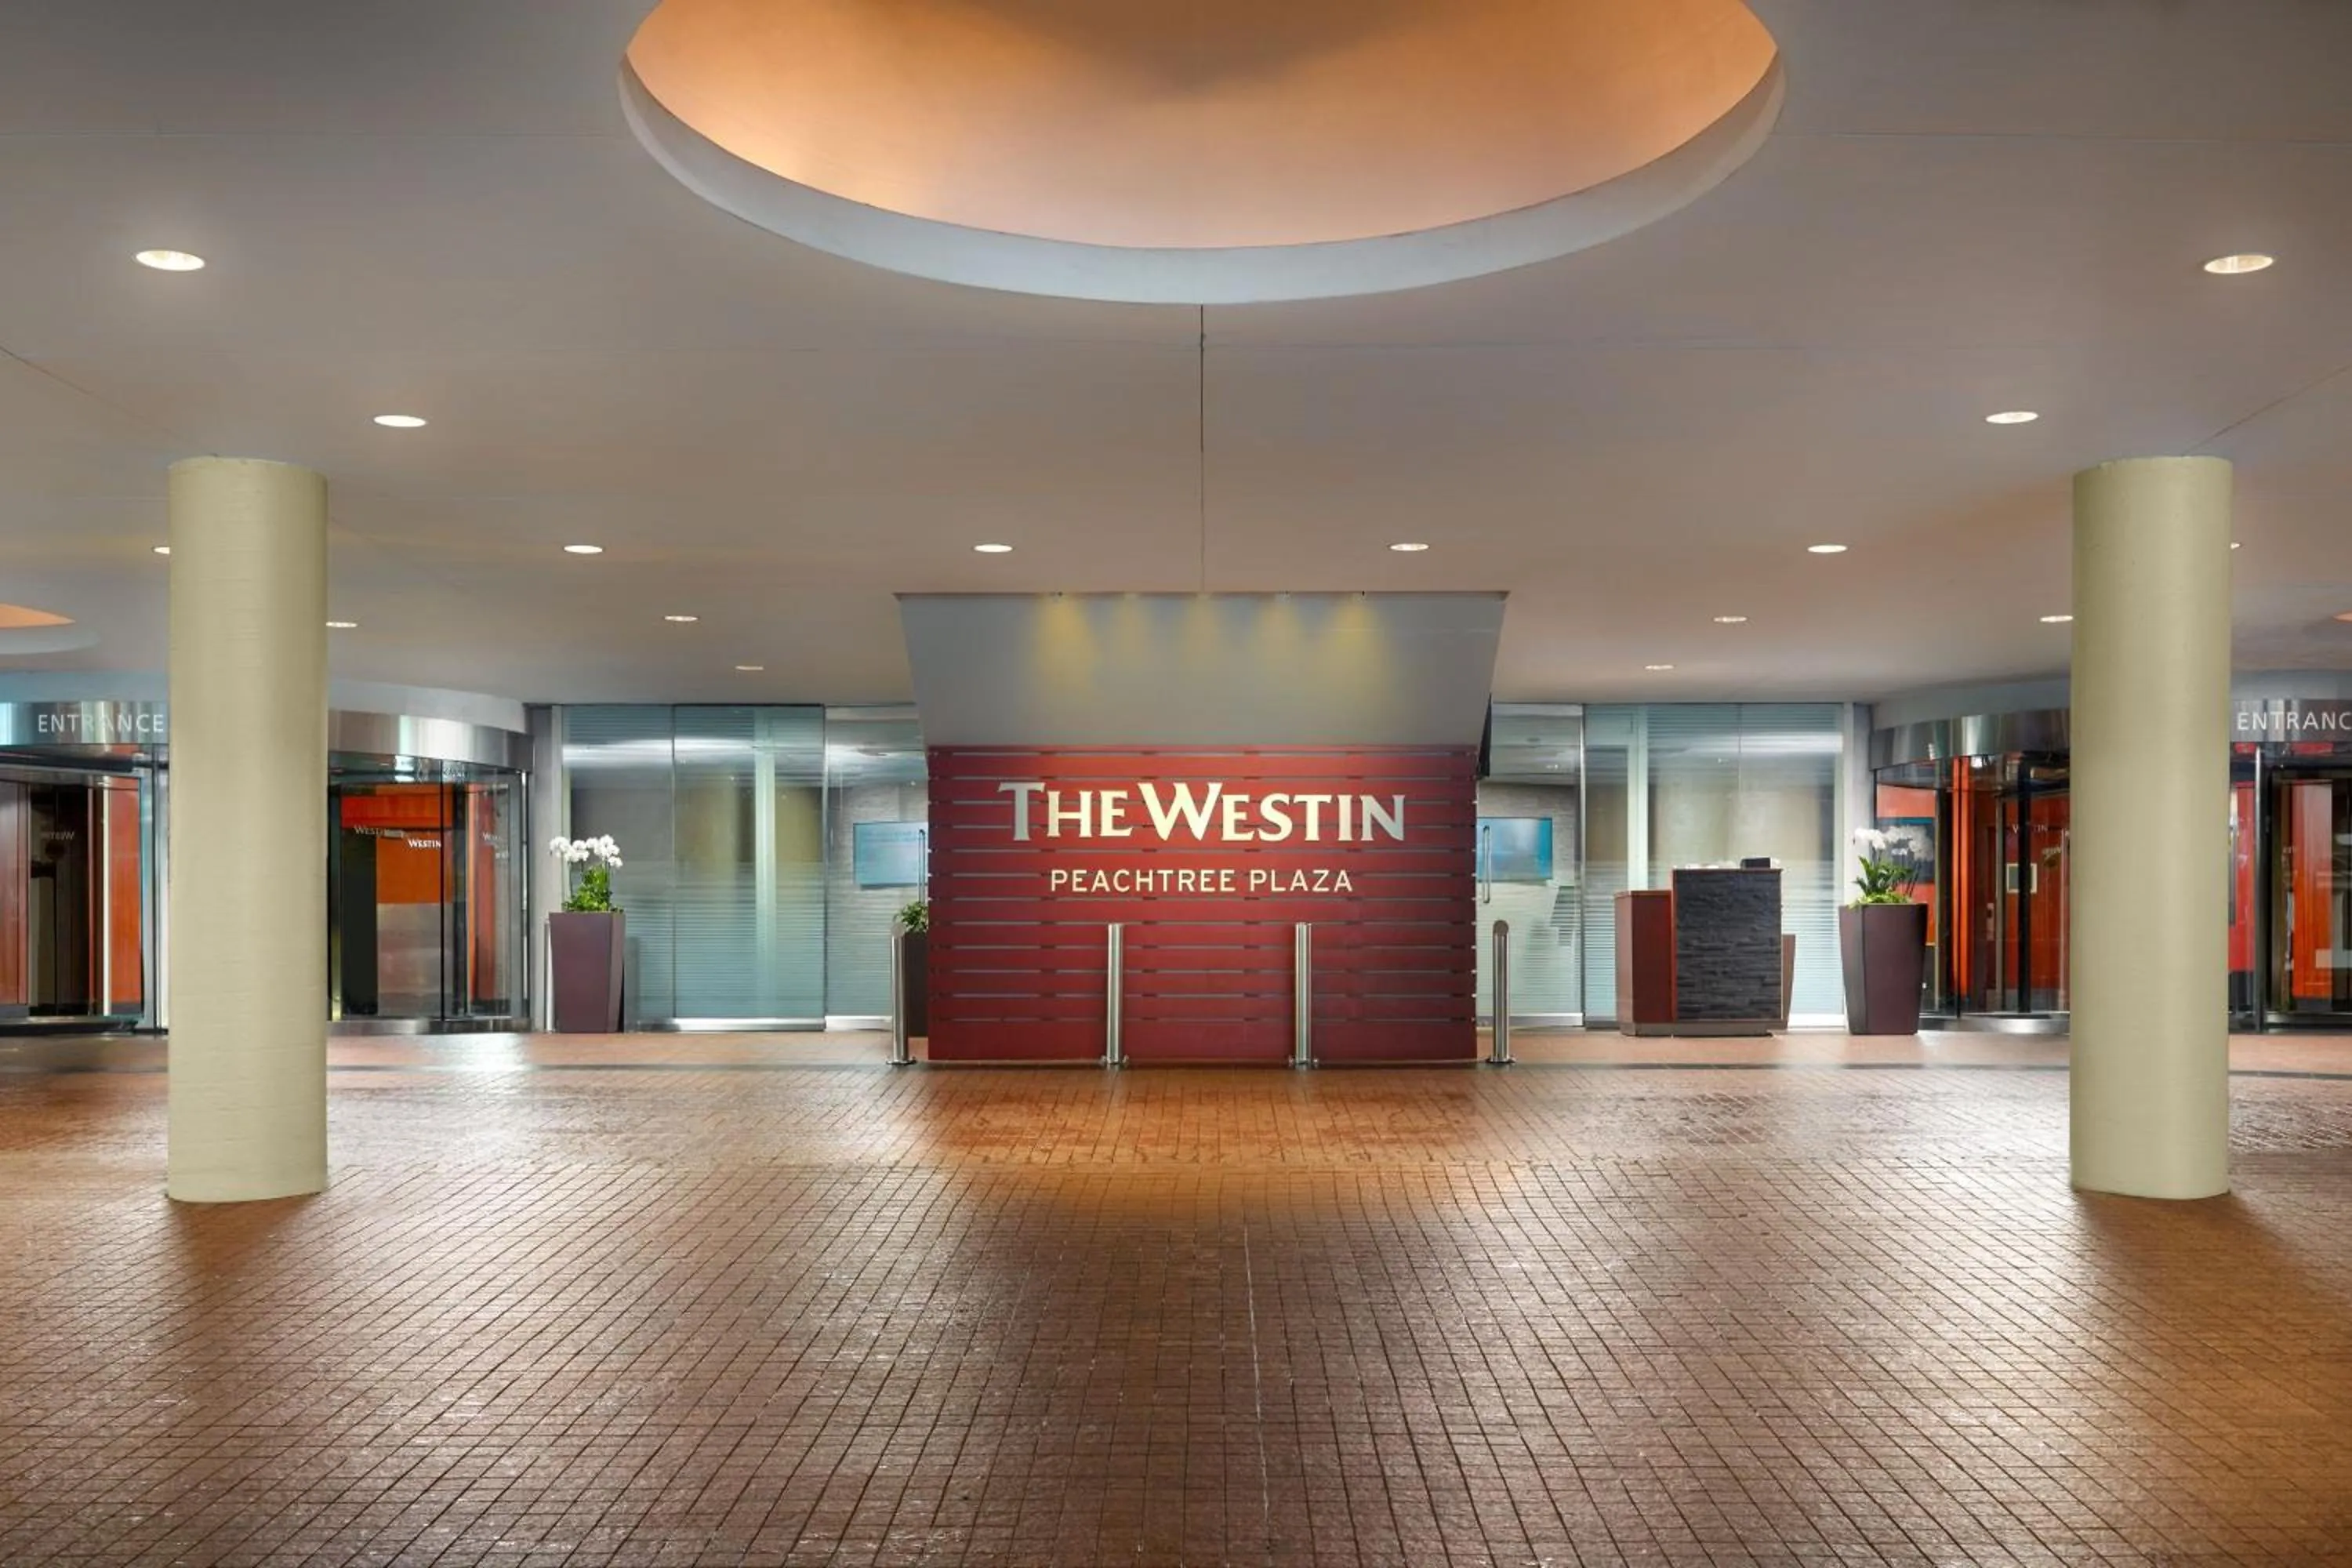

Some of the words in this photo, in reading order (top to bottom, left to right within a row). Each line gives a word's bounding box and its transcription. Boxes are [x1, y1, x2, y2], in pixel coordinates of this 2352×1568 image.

[38, 713, 164, 732] ENTRANCE
[998, 782, 1134, 841] THE
[1138, 782, 1405, 841] WESTIN
[1051, 869, 1236, 891] PEACHTREE
[1250, 869, 1352, 891] PLAZA
